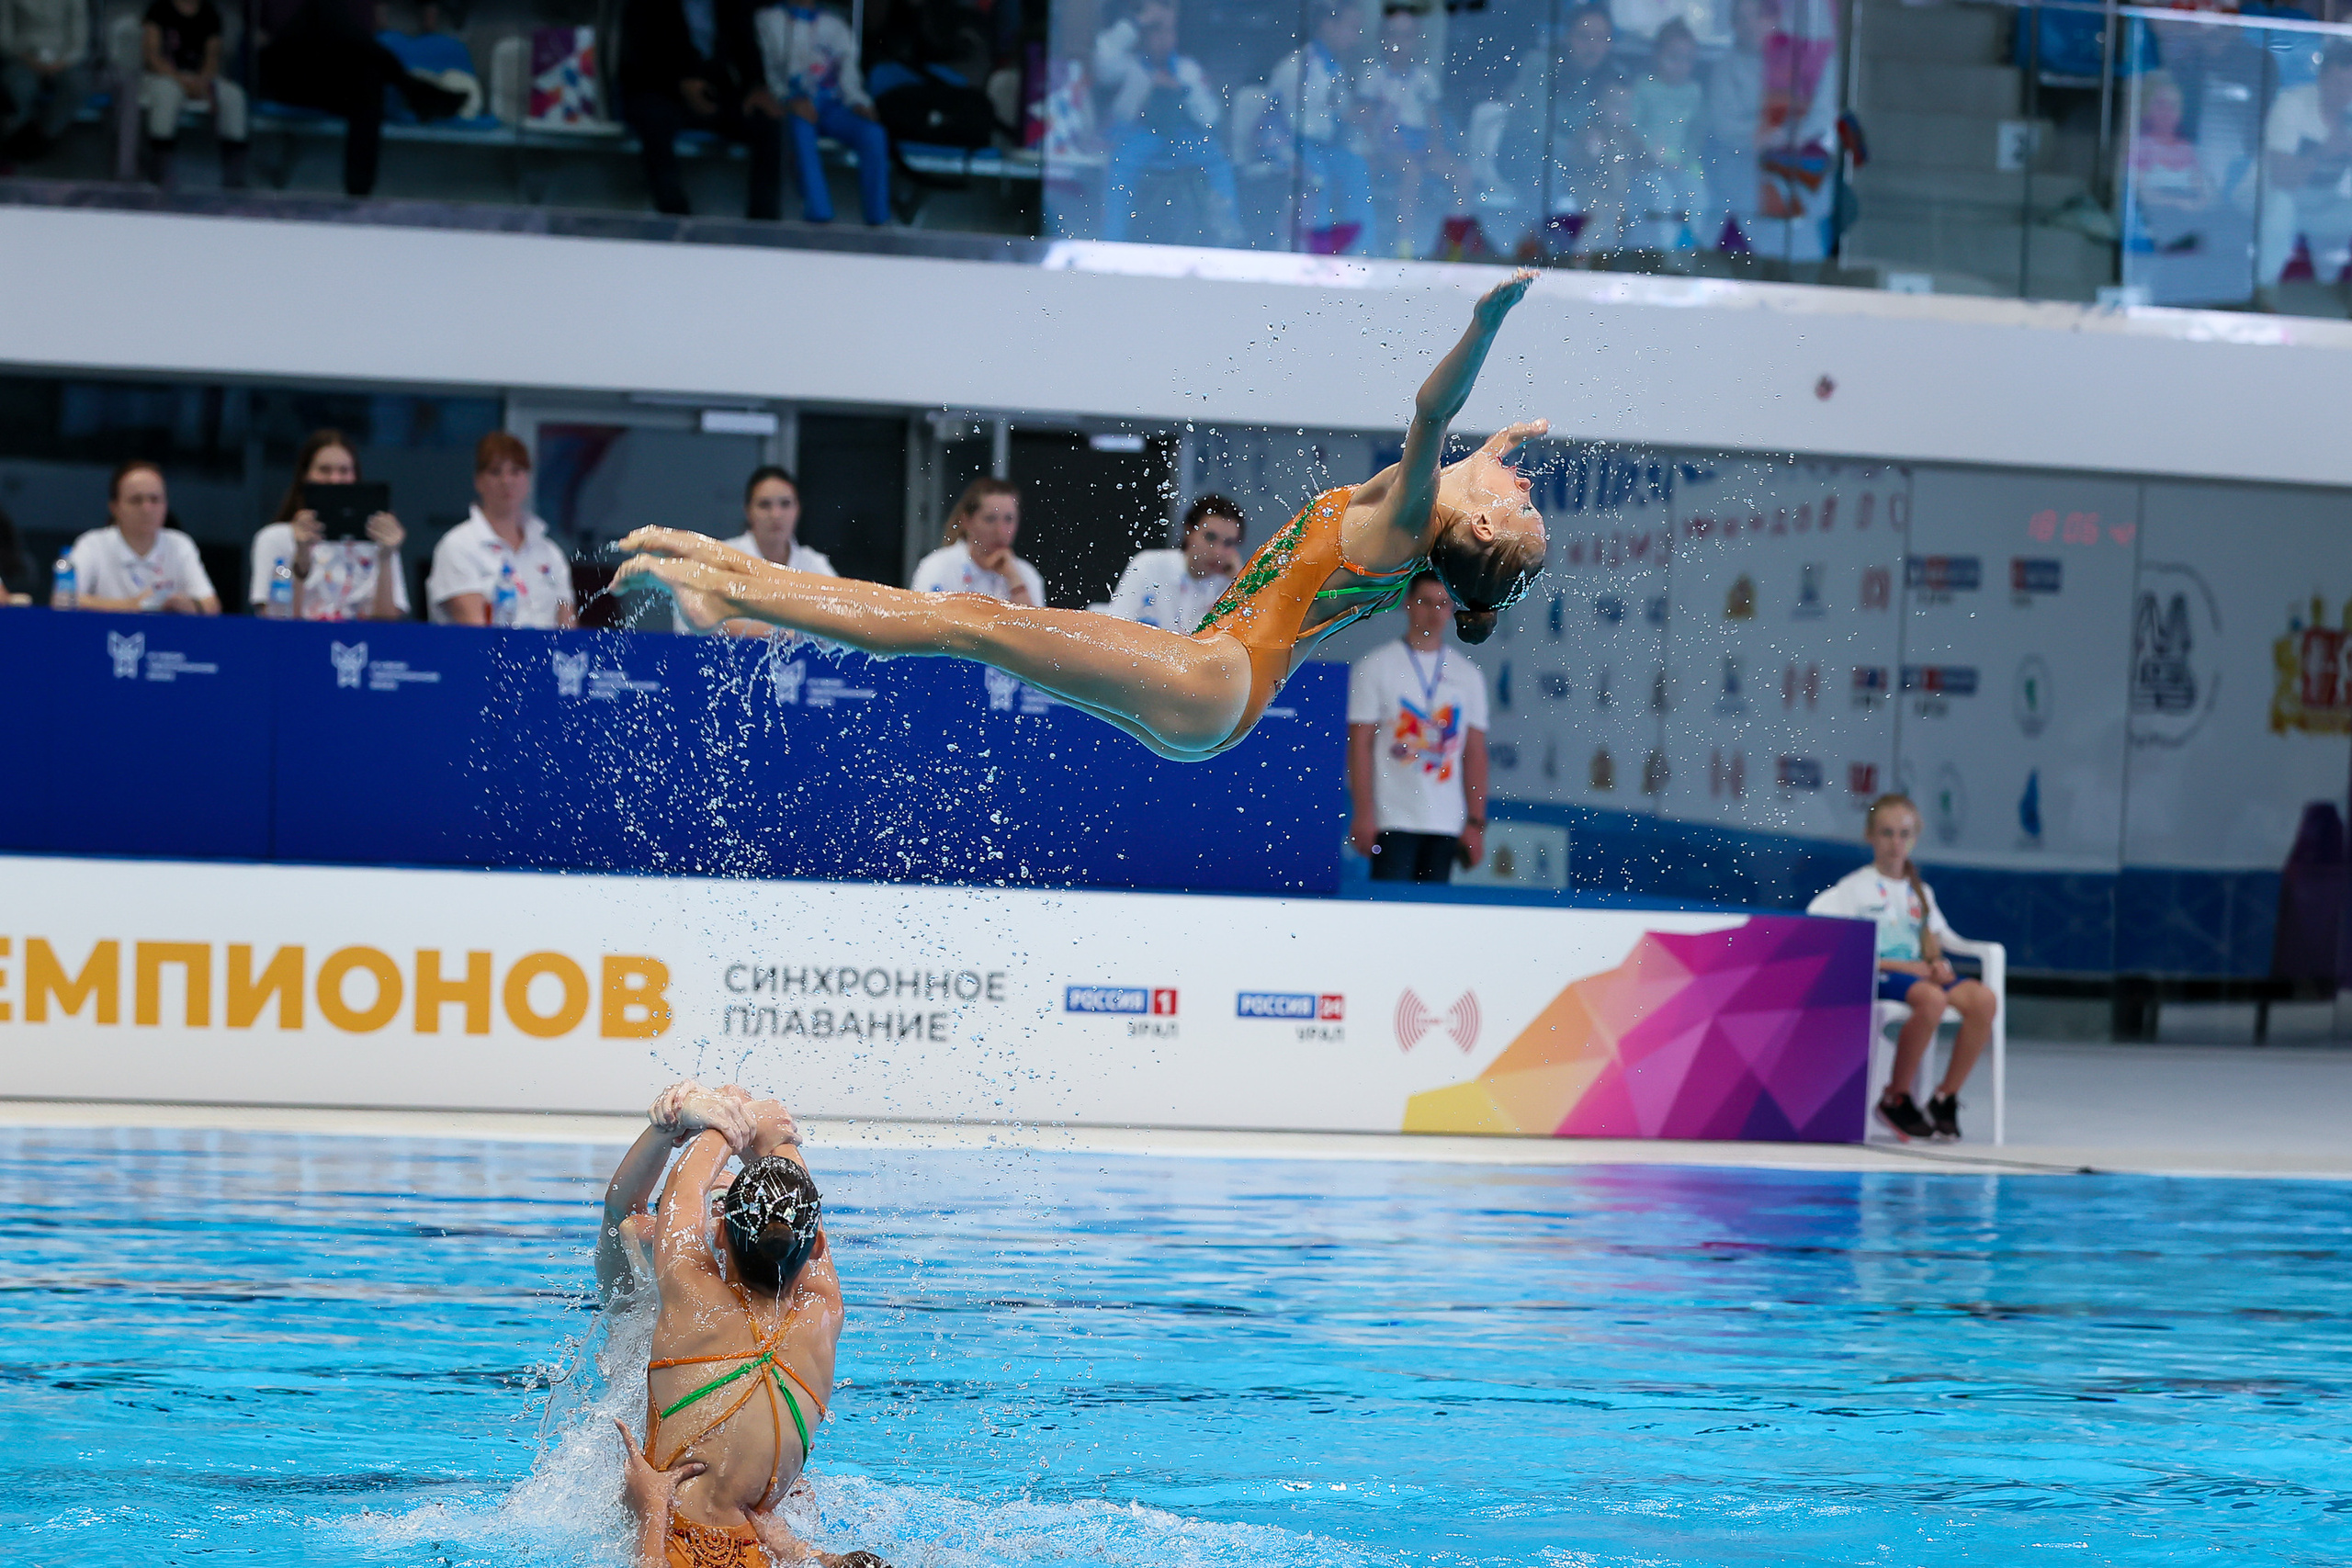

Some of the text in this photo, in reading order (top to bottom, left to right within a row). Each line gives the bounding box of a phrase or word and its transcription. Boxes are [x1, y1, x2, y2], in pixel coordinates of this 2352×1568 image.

[0, 936, 673, 1040] МПИОНОВ
[724, 963, 1007, 1001] СИНХРОННОЕ
[1068, 988, 1172, 1013] РОССИЯ 1
[1239, 995, 1314, 1016] РОССИЯ
[722, 1006, 949, 1043] ПЛАВАНИЕ
